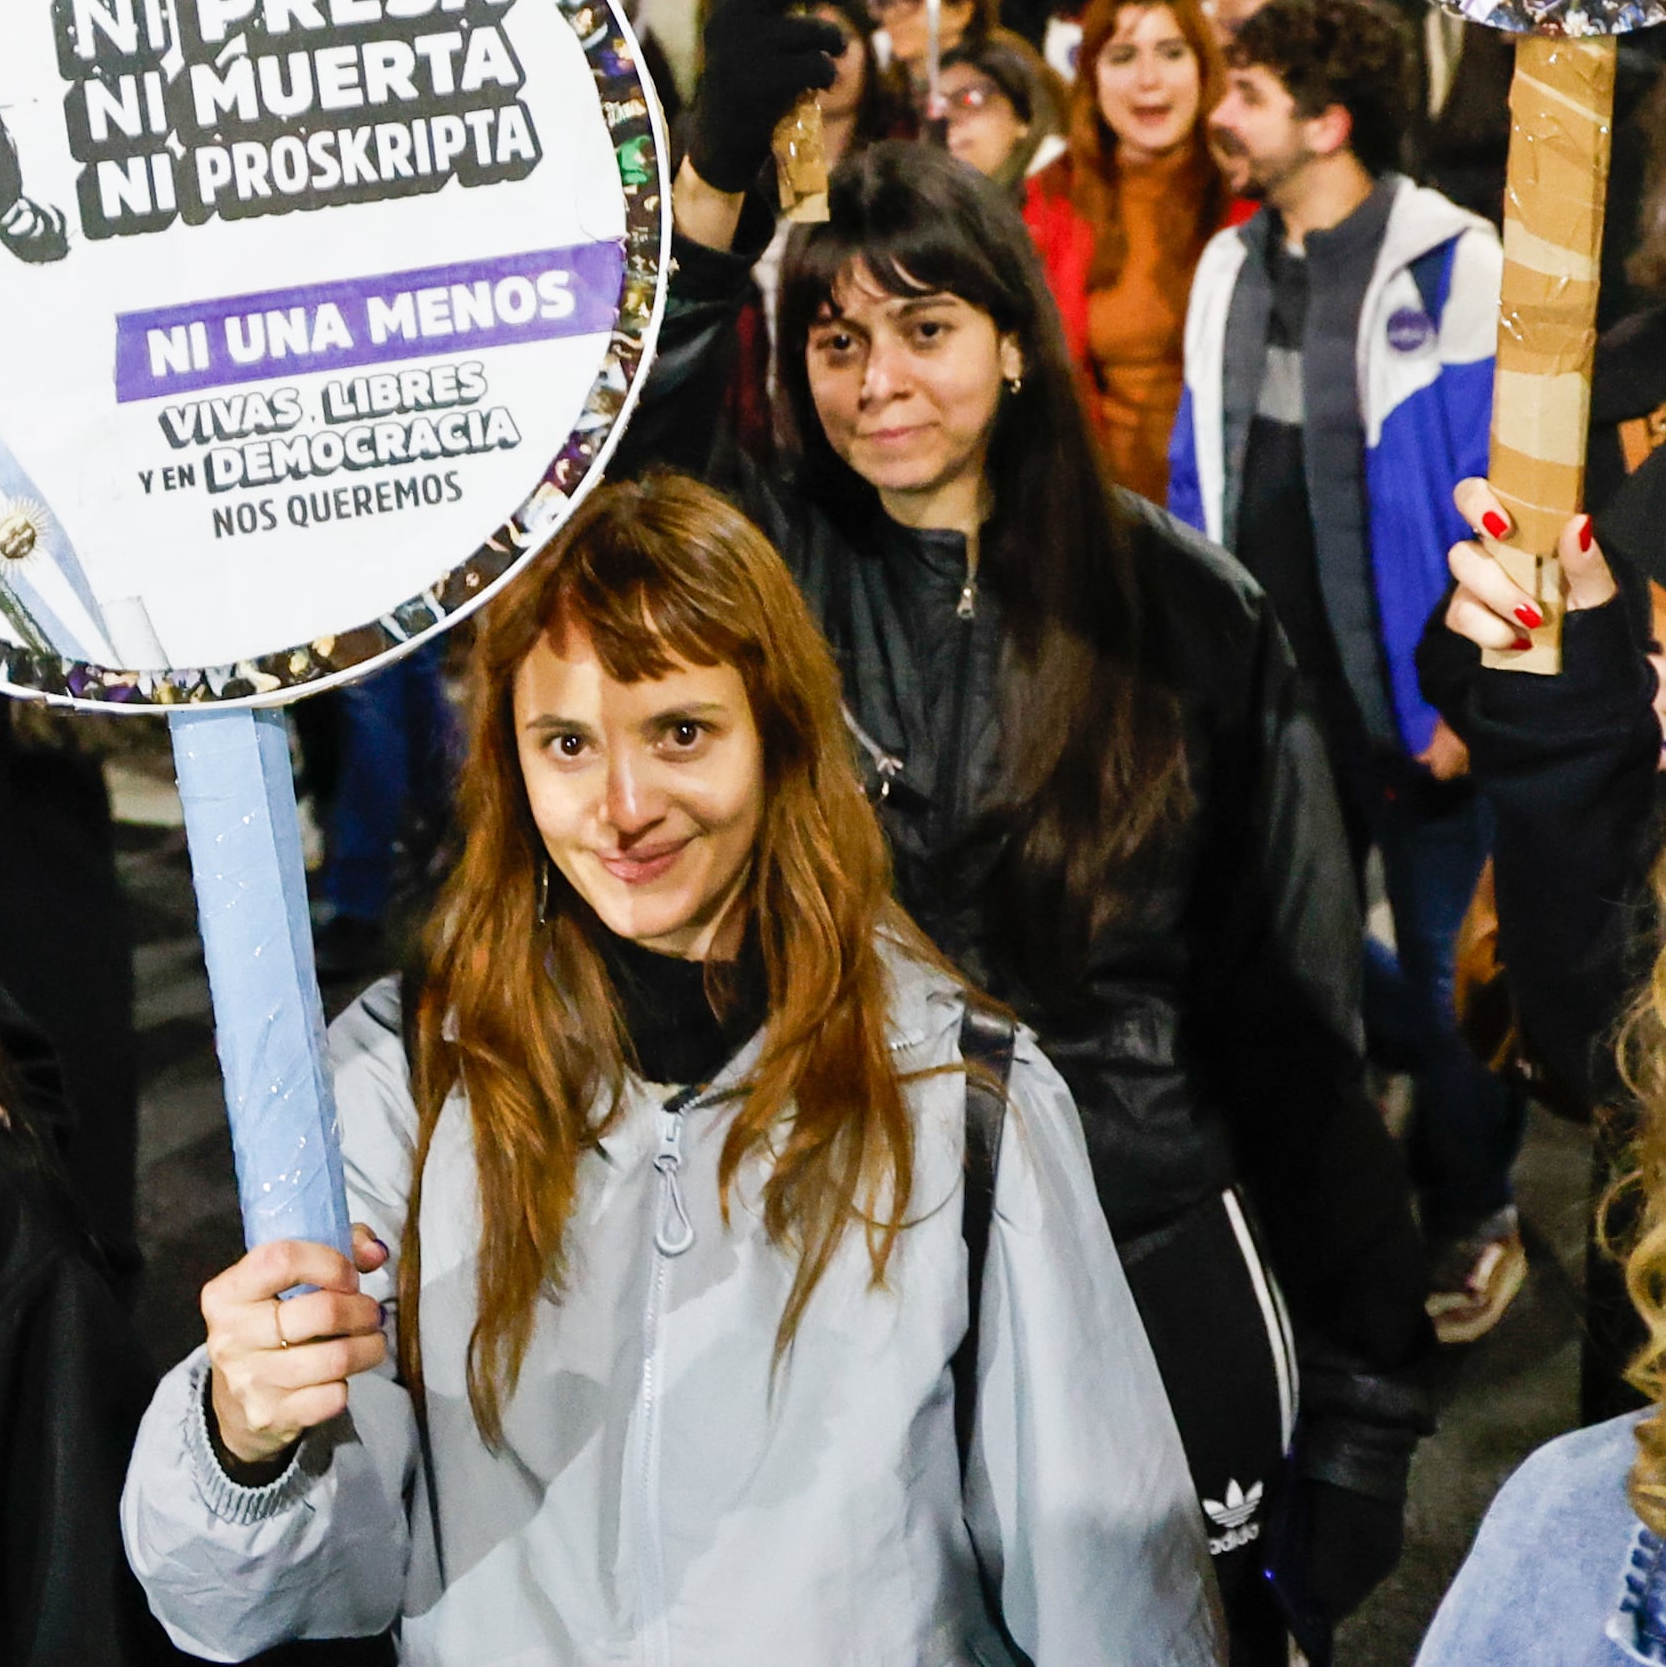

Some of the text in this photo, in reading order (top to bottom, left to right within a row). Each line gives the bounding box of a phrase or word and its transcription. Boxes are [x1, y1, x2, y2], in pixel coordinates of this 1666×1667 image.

[75, 22, 524, 149] NI MUERTA
[88, 101, 540, 227] NI PROSKRIPTA
[146, 269, 577, 378] NI UNA MENOS
[322, 361, 488, 424] LIBRES
[138, 406, 521, 494] Y EN DEMOCRACIA
[212, 470, 463, 538] NOS QUEREMOS
